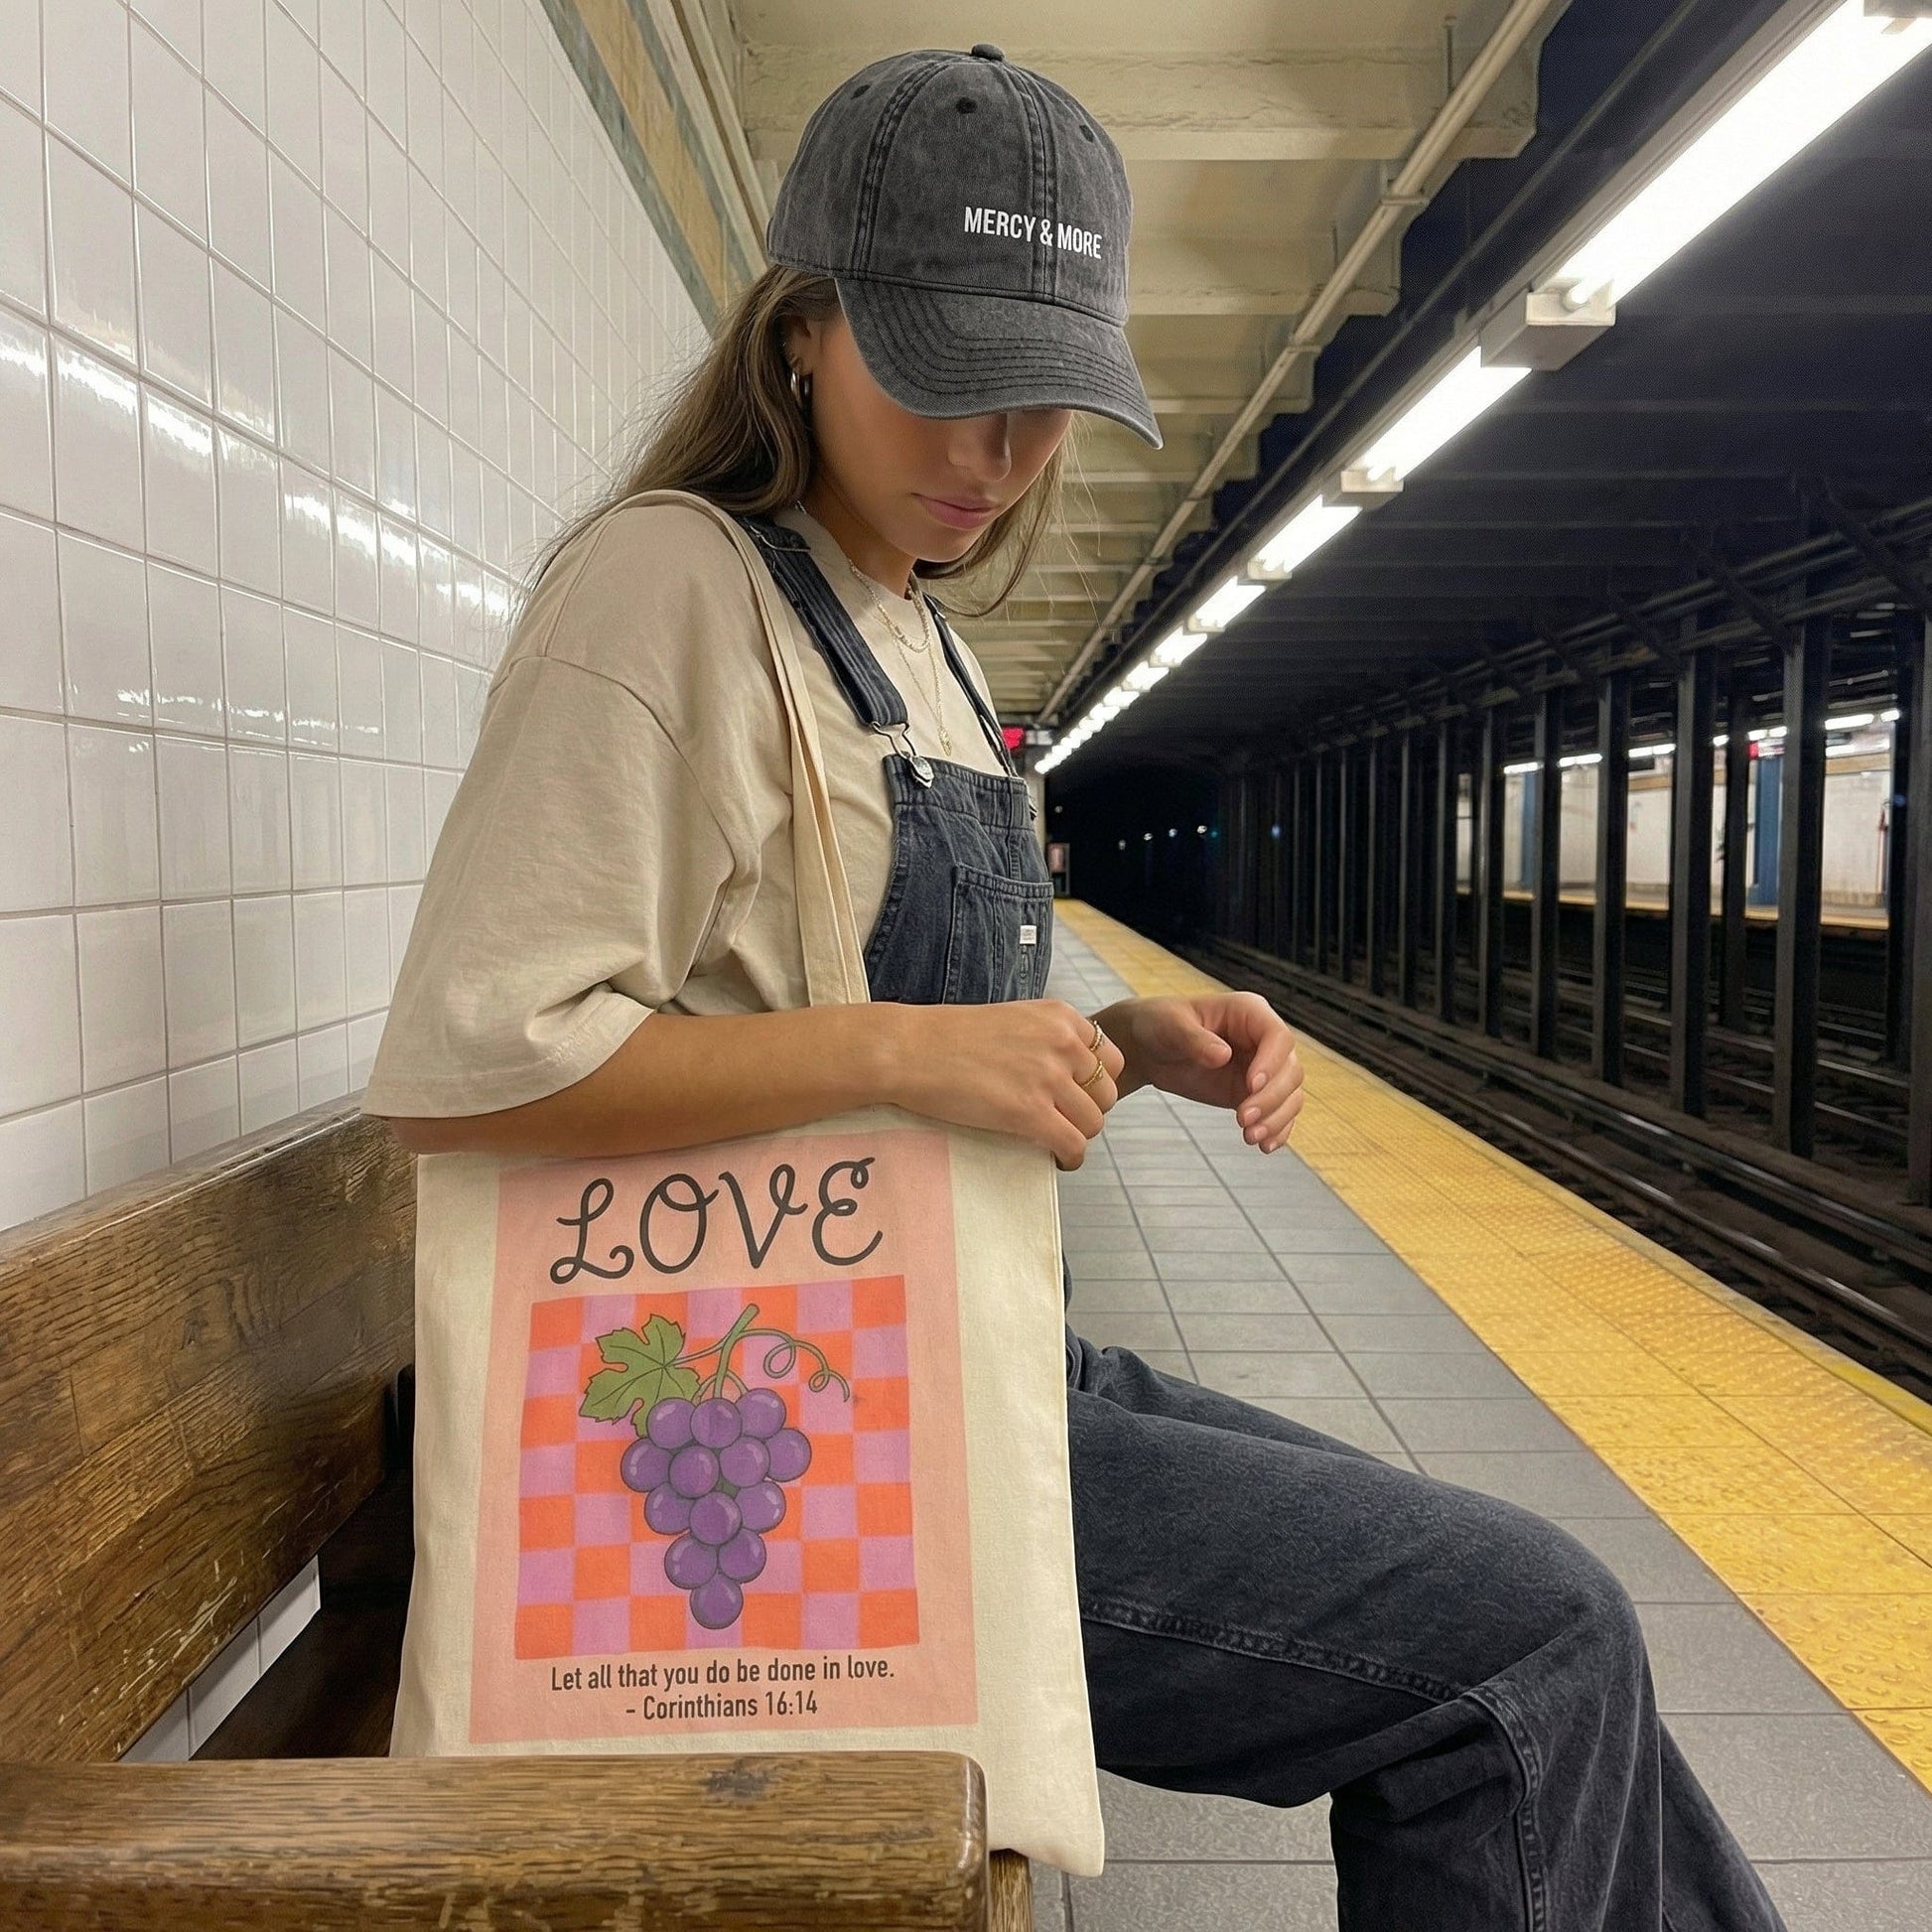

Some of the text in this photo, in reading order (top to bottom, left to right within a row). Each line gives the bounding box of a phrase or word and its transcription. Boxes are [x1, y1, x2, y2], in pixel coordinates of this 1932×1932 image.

[964, 206, 1103, 260] MERCY & MORE
[549, 1157, 884, 1285] LOVE
[551, 1654, 895, 1693] Let all that you do be done in love.
[643, 1692, 759, 1721] Corinthians
[764, 1690, 818, 1717] 16:14
